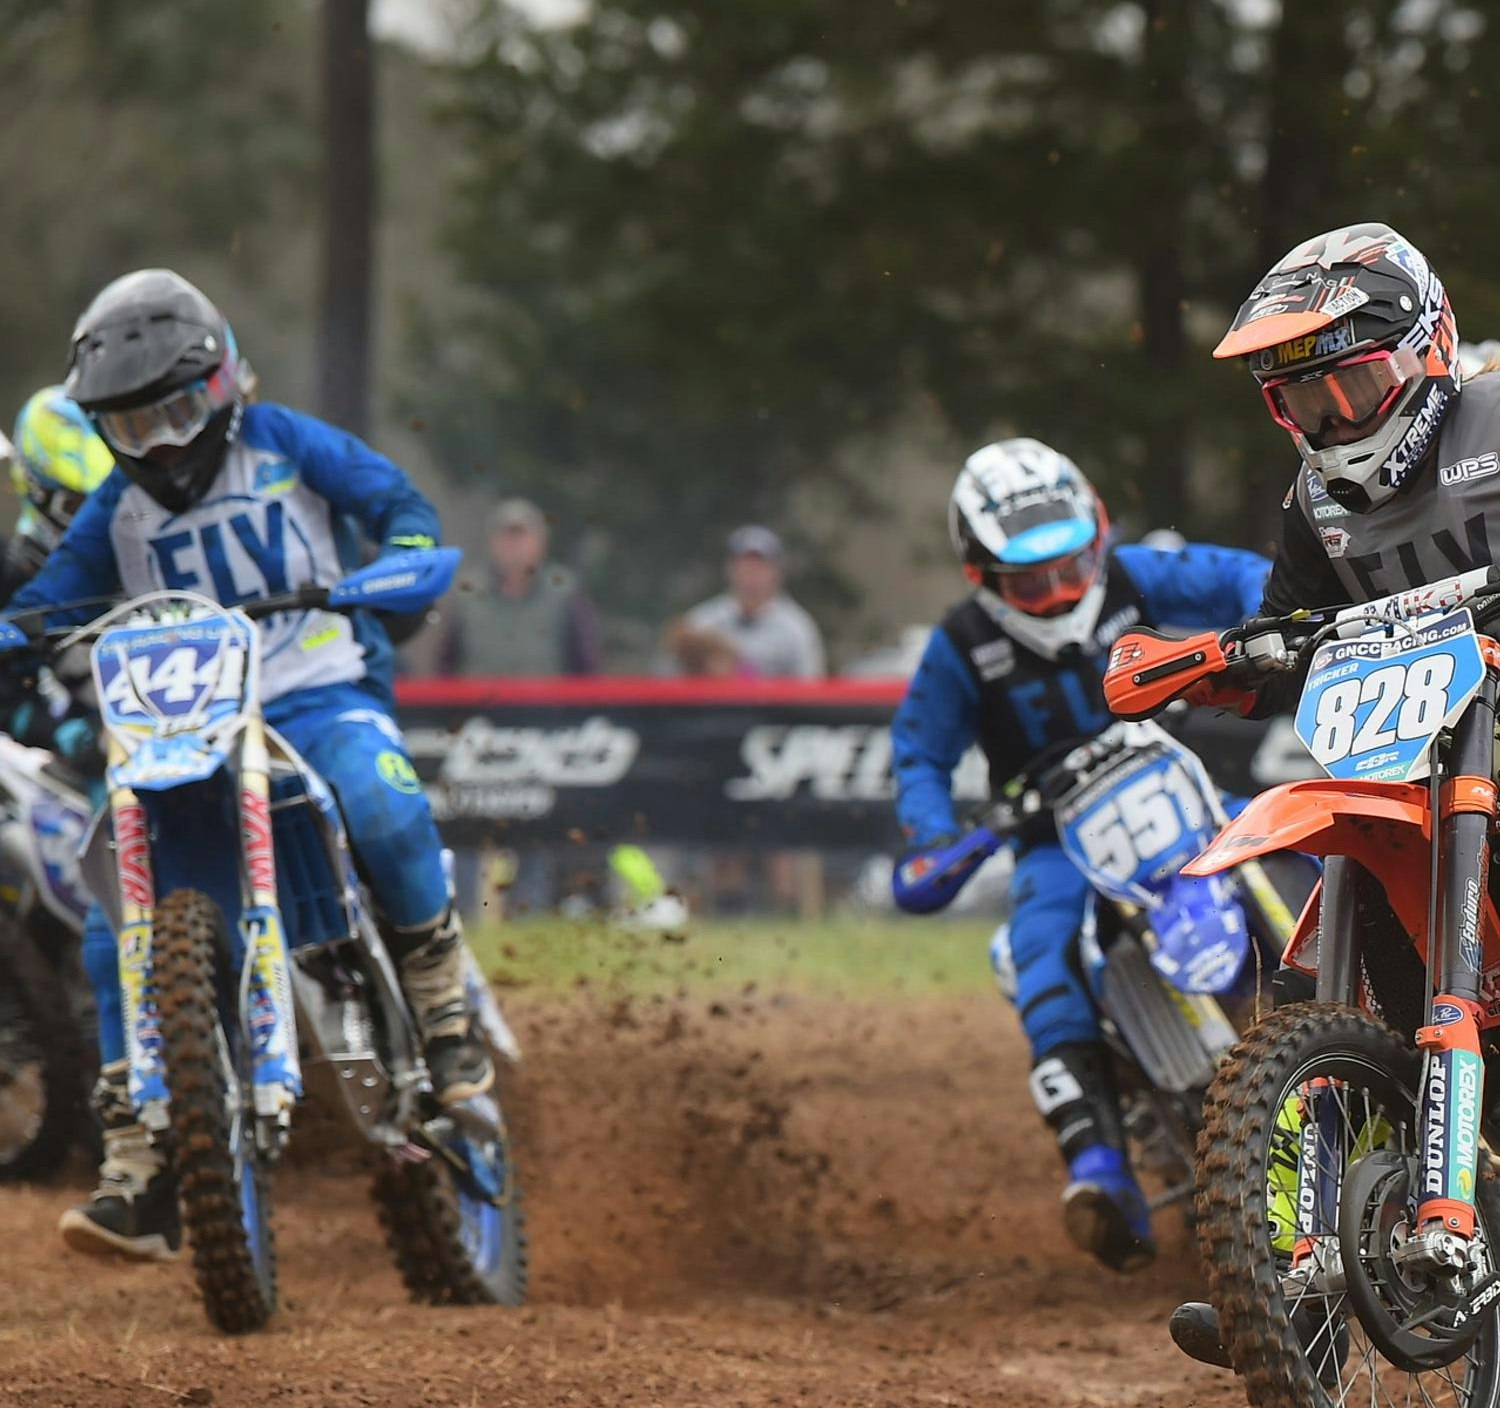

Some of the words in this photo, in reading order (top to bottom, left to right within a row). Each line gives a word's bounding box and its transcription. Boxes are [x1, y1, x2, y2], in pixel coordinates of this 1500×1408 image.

[1383, 383, 1442, 484] XTREME
[1443, 453, 1499, 484] WPS
[147, 501, 292, 610] FLY
[104, 647, 245, 715] 444
[1307, 662, 1360, 692] TRICKER
[1311, 653, 1456, 766] 828
[1076, 762, 1202, 884] 551
[1462, 879, 1479, 944] Enduro
[1426, 1054, 1447, 1197] DUNLOP
[1456, 1059, 1478, 1168] MOTOREX
[1299, 1122, 1319, 1235] UNLOP
